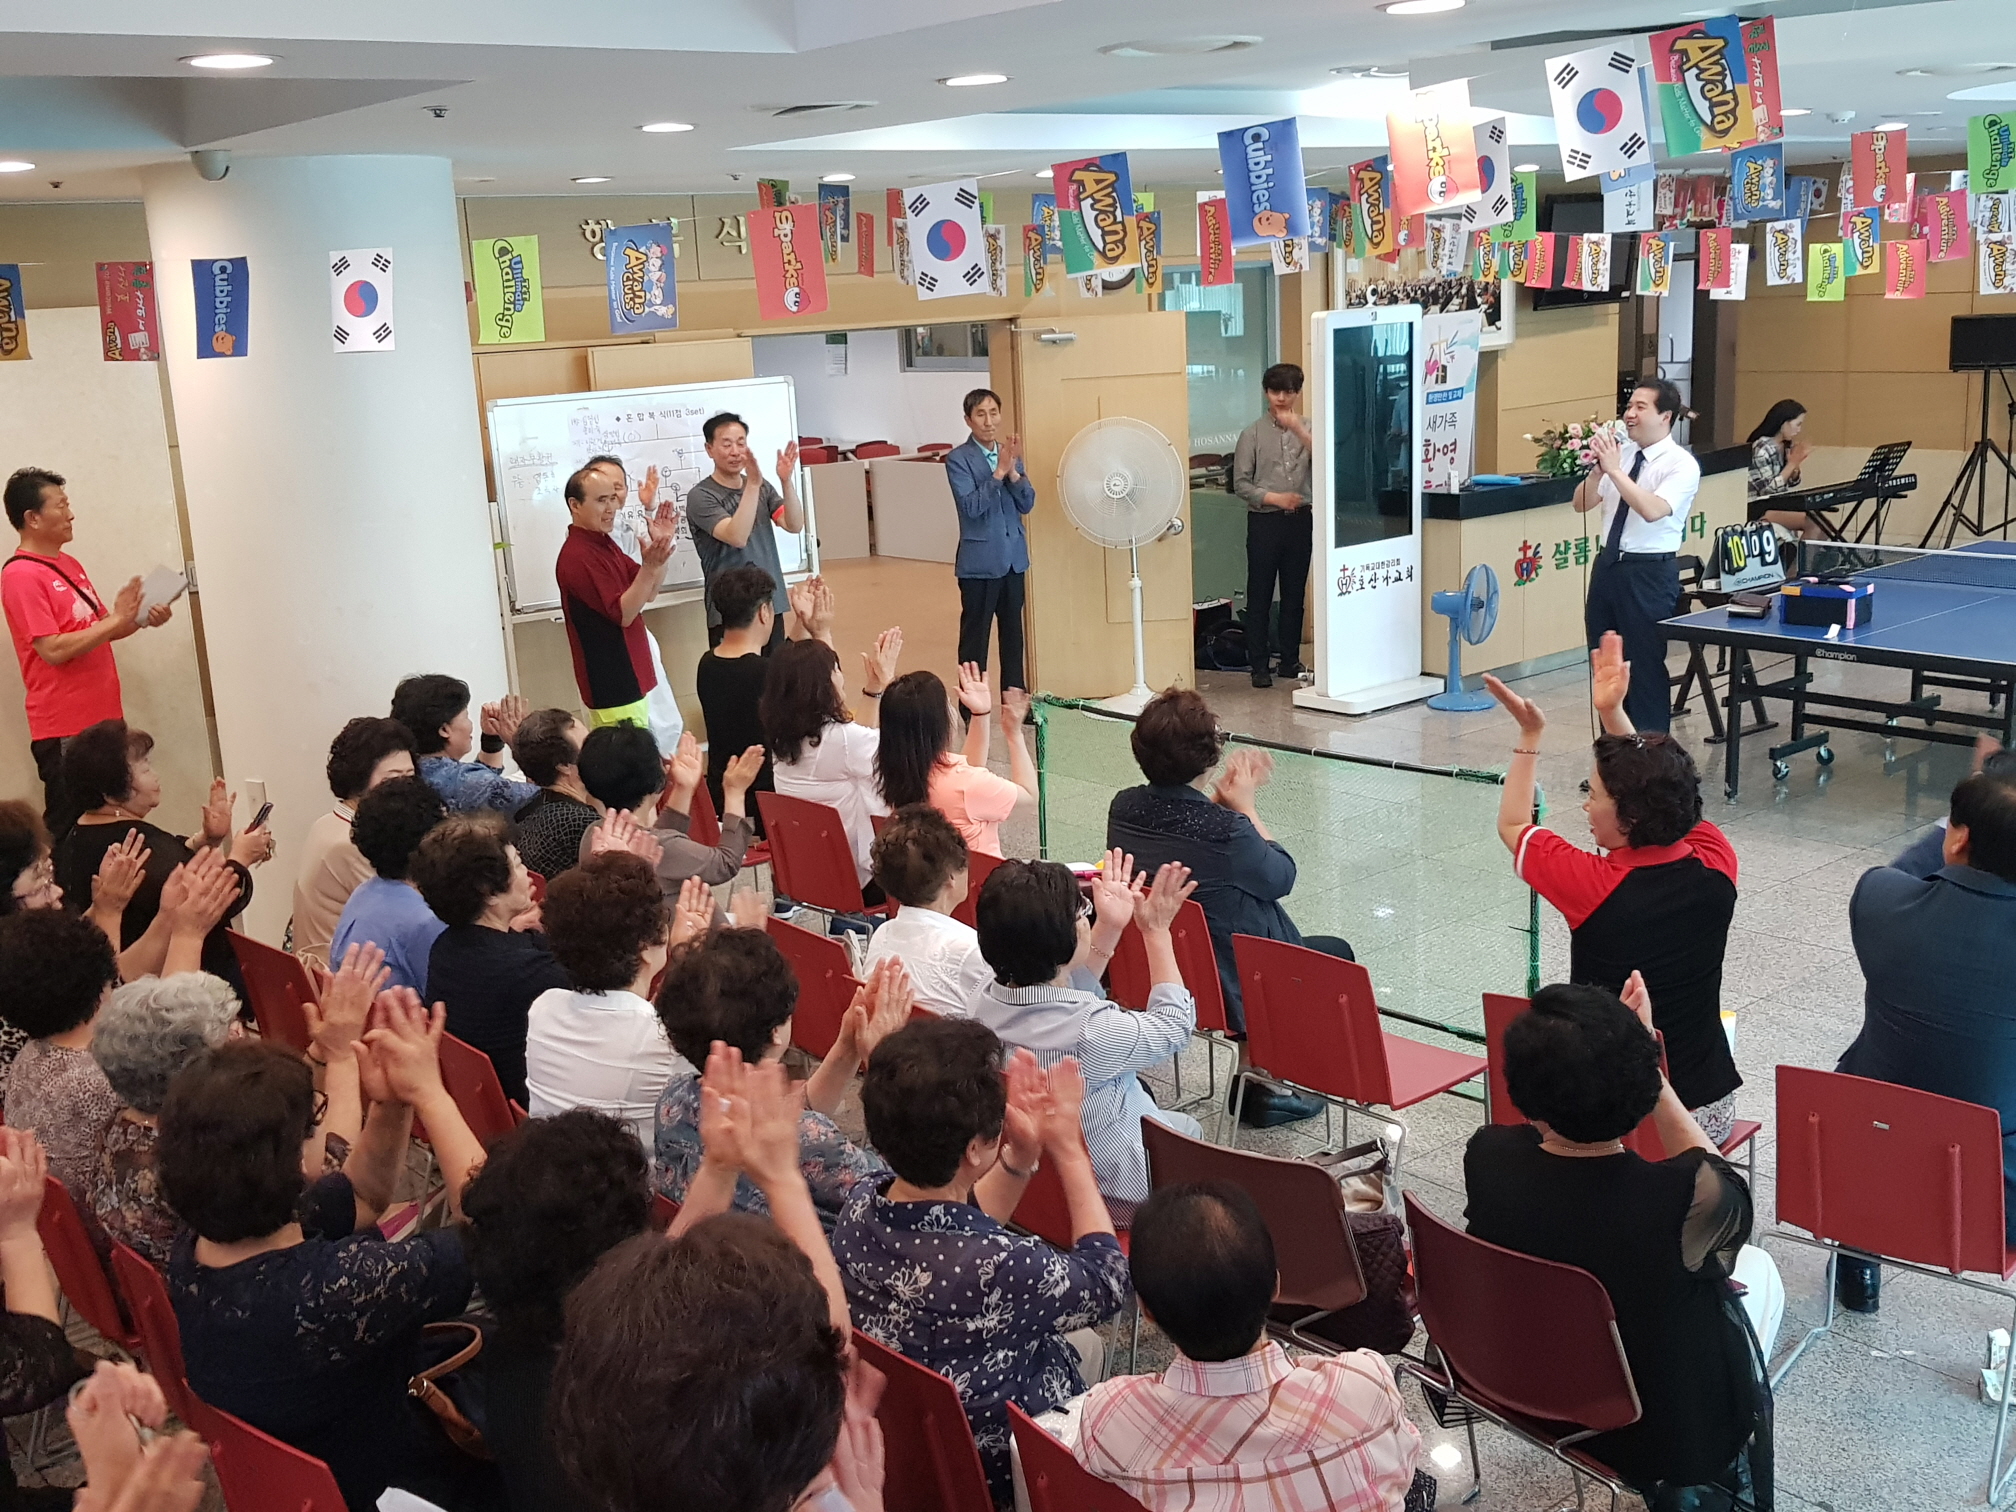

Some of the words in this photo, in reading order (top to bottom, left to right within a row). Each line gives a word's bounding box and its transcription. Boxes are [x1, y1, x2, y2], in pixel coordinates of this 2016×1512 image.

[1671, 37, 1738, 133] Awana
[1243, 126, 1275, 213] Cubbies
[1871, 132, 1890, 185] Sparks
[1983, 114, 2002, 188] Challenge
[1357, 168, 1385, 246] Awana
[1745, 160, 1763, 207] Awana
[716, 215, 747, 255] 식
[1069, 167, 1127, 260] Awana
[1936, 196, 1949, 259] Adventure
[773, 209, 803, 290] Sparks
[1027, 228, 1044, 293] Awana
[1138, 218, 1158, 288] Awana
[1480, 231, 1492, 277] Awana
[1588, 241, 1601, 285] Awana
[1648, 236, 1666, 287] Awana
[1773, 229, 1788, 279] Awana
[1851, 214, 1873, 267] Awana
[1988, 241, 2007, 289] Awana
[211, 259, 232, 333] Cubbies
[493, 239, 515, 338] Challenge
[511, 254, 524, 312] Ultimate
[623, 247, 648, 315] Awana
[1816, 244, 1831, 298] Challenge
[1895, 242, 1909, 297] Adventure
[106, 320, 122, 360] Awana
[1194, 433, 1238, 447] HOSANNA
[1426, 411, 1458, 432] 새가족
[1360, 558, 1400, 572] 기독교대한감리회
[1727, 535, 1745, 568] 10
[1751, 535, 1760, 556] 0
[1762, 530, 1775, 563] 9
[1741, 573, 1774, 583] CHAMPION
[1815, 648, 1857, 661] Champion
